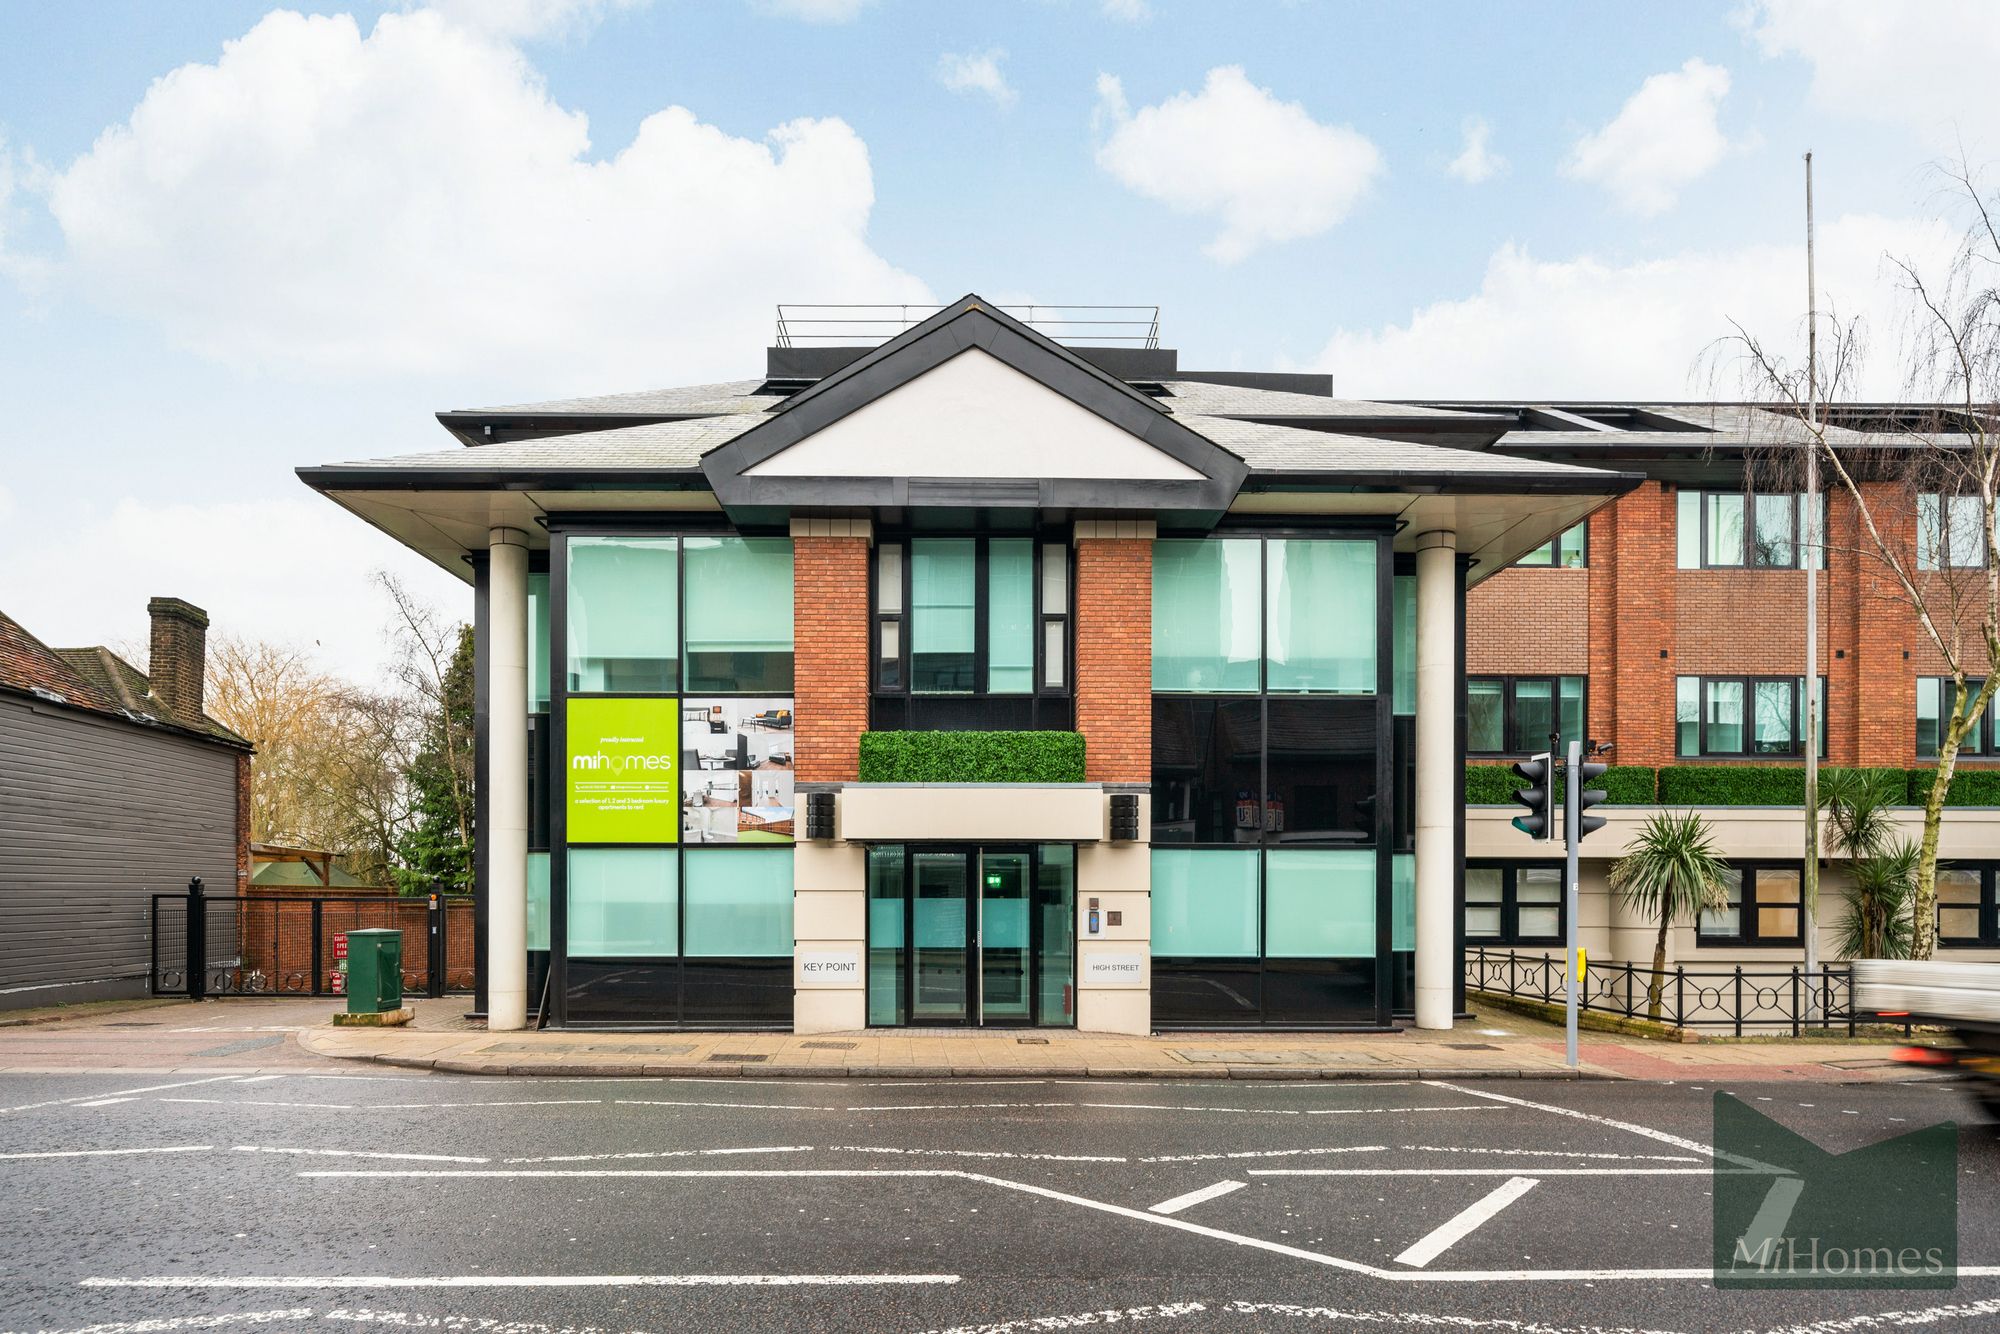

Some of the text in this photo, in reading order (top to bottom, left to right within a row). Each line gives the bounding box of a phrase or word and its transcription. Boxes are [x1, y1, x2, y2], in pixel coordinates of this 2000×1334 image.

[573, 750, 671, 776] mihomes
[803, 962, 856, 971] KEY POINT
